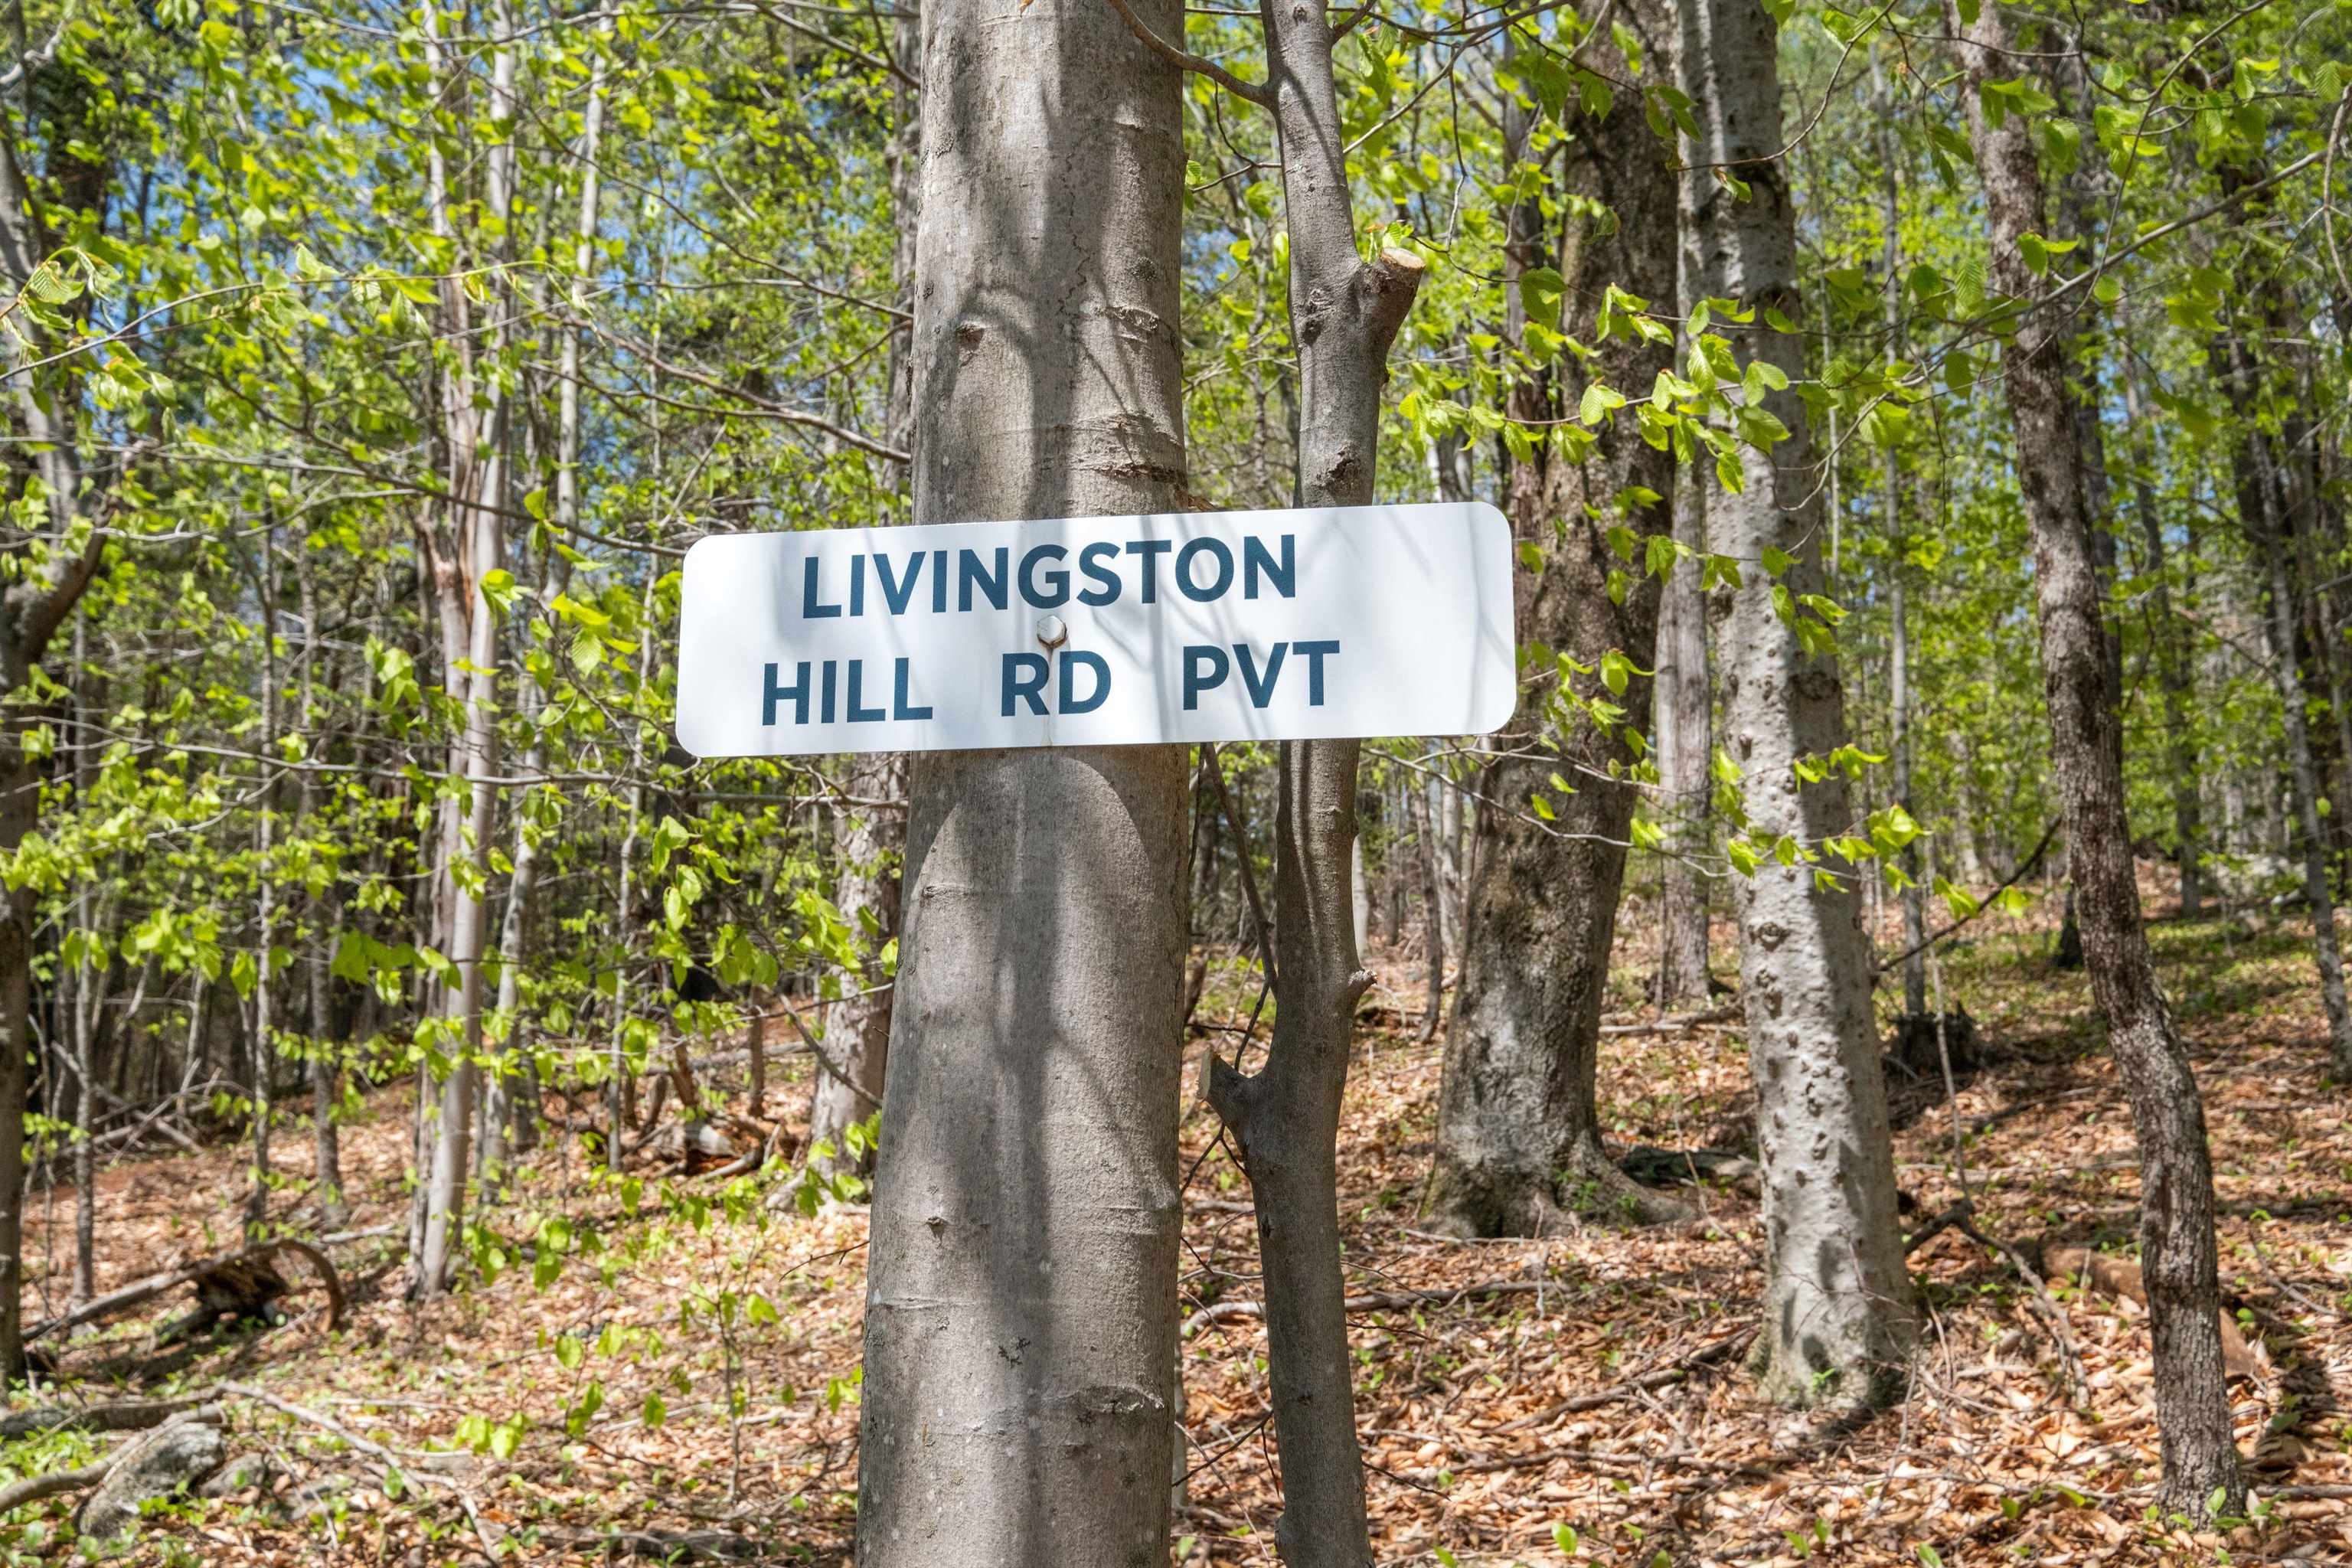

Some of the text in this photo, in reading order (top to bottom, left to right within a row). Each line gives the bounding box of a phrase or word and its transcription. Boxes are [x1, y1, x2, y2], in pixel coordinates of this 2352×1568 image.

[802, 534, 1295, 619] LIVINGSTON
[762, 640, 1340, 726] HILL RD PVT
